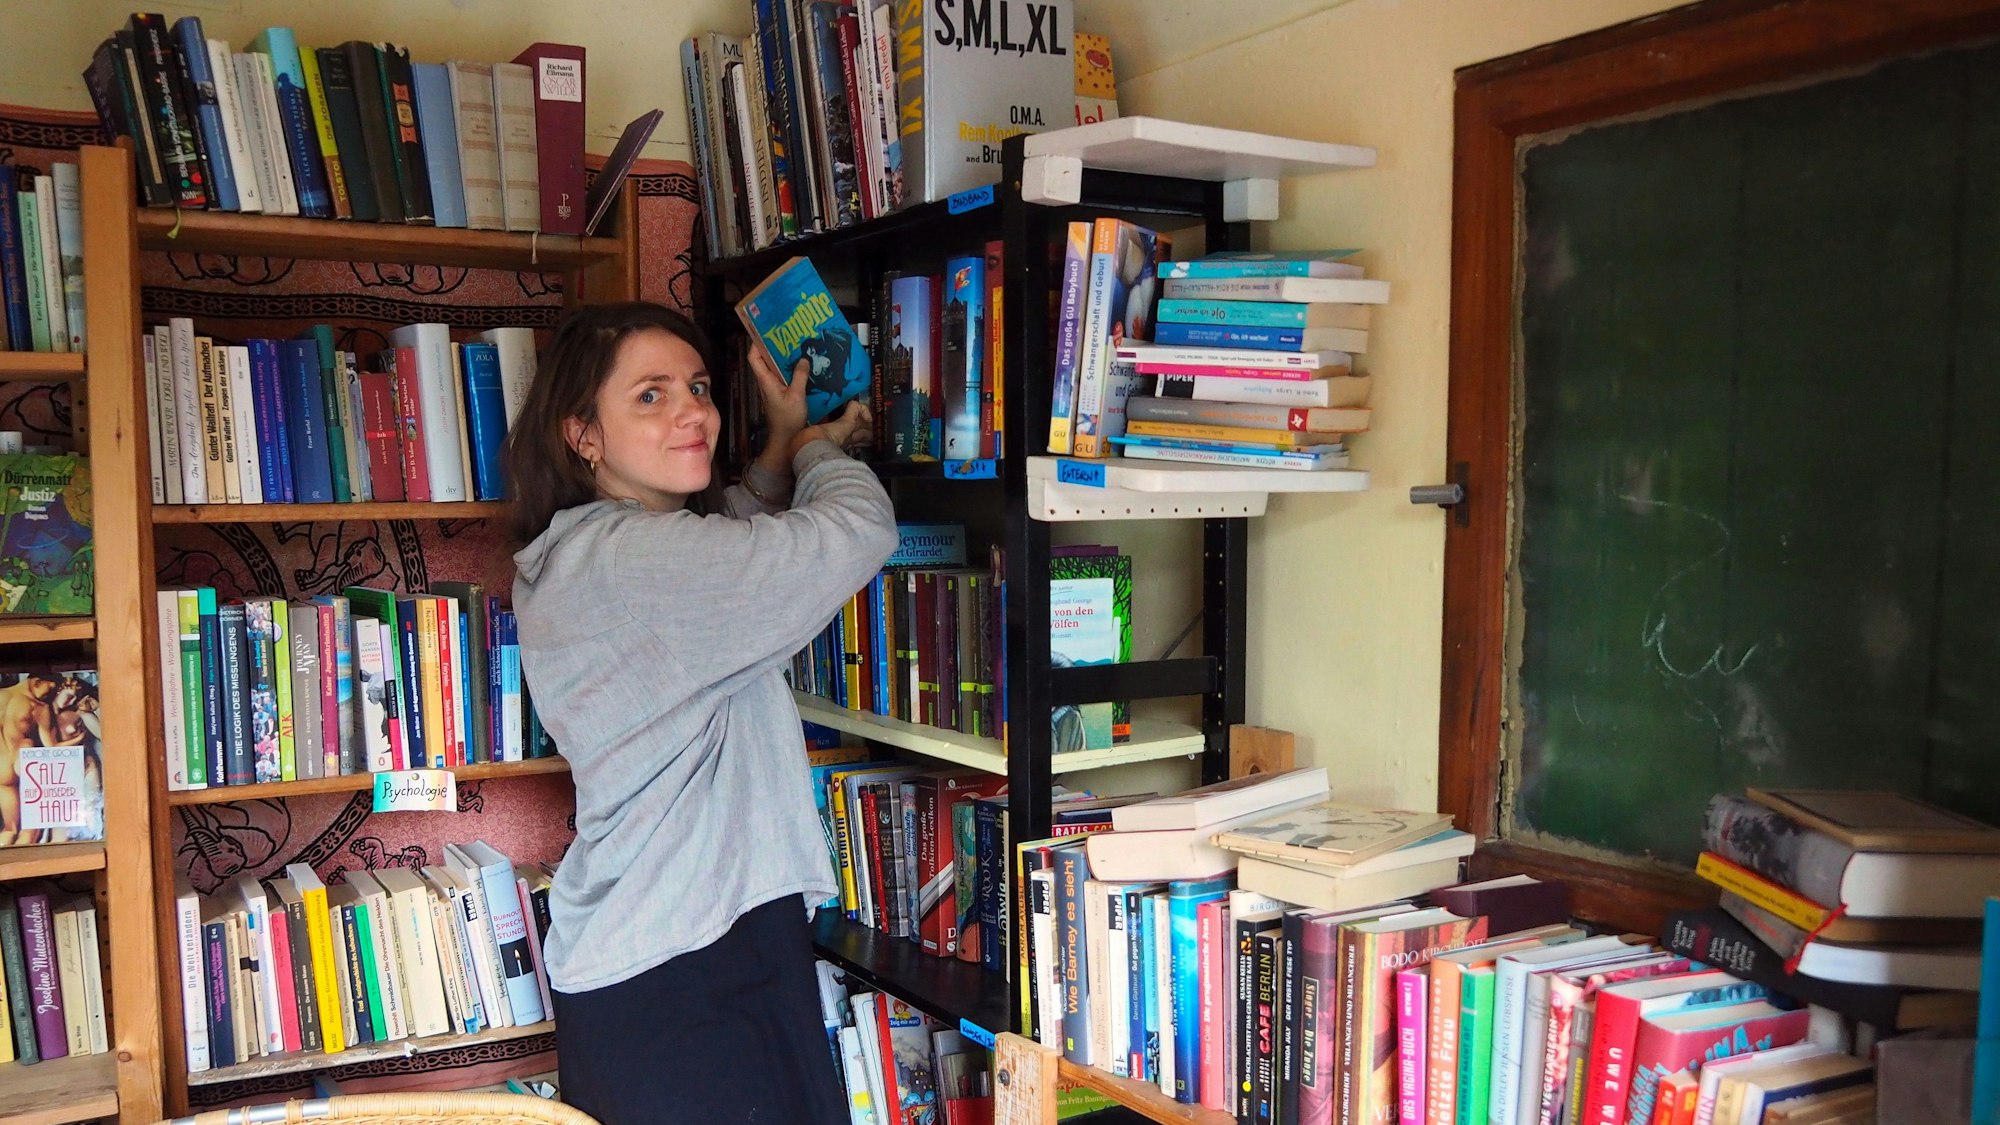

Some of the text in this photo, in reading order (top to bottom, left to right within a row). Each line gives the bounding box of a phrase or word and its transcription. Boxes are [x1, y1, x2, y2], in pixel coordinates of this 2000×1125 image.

[935, 0, 1067, 58] S,M,L,XL
[547, 63, 573, 73] Richard
[1010, 105, 1046, 127] O.M.A.
[312, 72, 348, 203] TOLSTOI KOSAKEN
[959, 121, 986, 143] Rem
[756, 138, 768, 203] INDIEN
[966, 154, 981, 164] and
[762, 289, 836, 358] Vampire
[1061, 261, 1078, 365] Das große GU Babybuch
[1086, 308, 1099, 380] Schwangerschaft
[1095, 258, 1104, 287] Geburt
[1210, 307, 1225, 319] Oje
[475, 353, 494, 362] ZOLA
[201, 341, 219, 461] Günter Wallraff Der Aufmacher
[221, 388, 229, 410] Zeugen
[873, 363, 885, 415] Letztendlich
[165, 407, 174, 434] WALSER
[223, 416, 231, 441] Wallraff
[167, 436, 176, 466] MARTIN
[1075, 443, 1093, 454] GU
[4, 469, 73, 486] Dürrenmatt
[19, 487, 56, 503] Justiz
[906, 546, 943, 557] Girardet
[217, 607, 244, 616] DIETRICH
[1075, 606, 1094, 615] den
[296, 633, 306, 673] JOURNEY
[302, 641, 317, 673] MAN
[323, 613, 332, 673] Jugendkriminalität
[165, 608, 177, 717] Wechseljahre Wandlungsjahre
[495, 669, 503, 686] durch
[228, 627, 243, 755] DIE LOGIK DES MISSLINGENS
[282, 713, 294, 739] ALK
[216, 741, 224, 783] Kohlhammer
[25, 760, 67, 803] SALZ
[42, 785, 77, 798] UNSERER
[382, 782, 447, 801] Psychologie
[40, 799, 81, 824] HAUT
[920, 811, 928, 840] große
[463, 893, 478, 922] PIPER
[1041, 883, 1050, 914] PIPER
[1113, 897, 1122, 931] PIPER
[495, 916, 523, 932] SPRECH
[496, 925, 526, 941] STUNDE
[1064, 860, 1077, 1013] Wie Barney es sieht
[26, 903, 57, 1013] Josefine Mutzenbacher
[184, 910, 196, 988] Die Welt verändern
[379, 930, 388, 961] Ohnmacht
[1382, 950, 1419, 967] BODO
[447, 976, 455, 989] King
[1203, 942, 1212, 1005] pragmatische
[387, 972, 396, 1011] Schmidbauer
[1259, 954, 1270, 1053] CAFE BERLIN
[1304, 984, 1314, 1018] Singer
[1303, 1029, 1313, 1046] Die
[1428, 979, 1441, 1117] Rosita Steenbeek
[1440, 1017, 1455, 1061] Frau
[1498, 977, 1512, 1104] DITLEV JENSEN LEIBSPEISE
[1402, 1028, 1415, 1096] VAGINA-BUCH
[1540, 1018, 1558, 1105] VEGETARIERIN
[1604, 1047, 1623, 1091] UWE
[1461, 1074, 1467, 1085] ES
[1402, 1099, 1415, 1120] DAS
